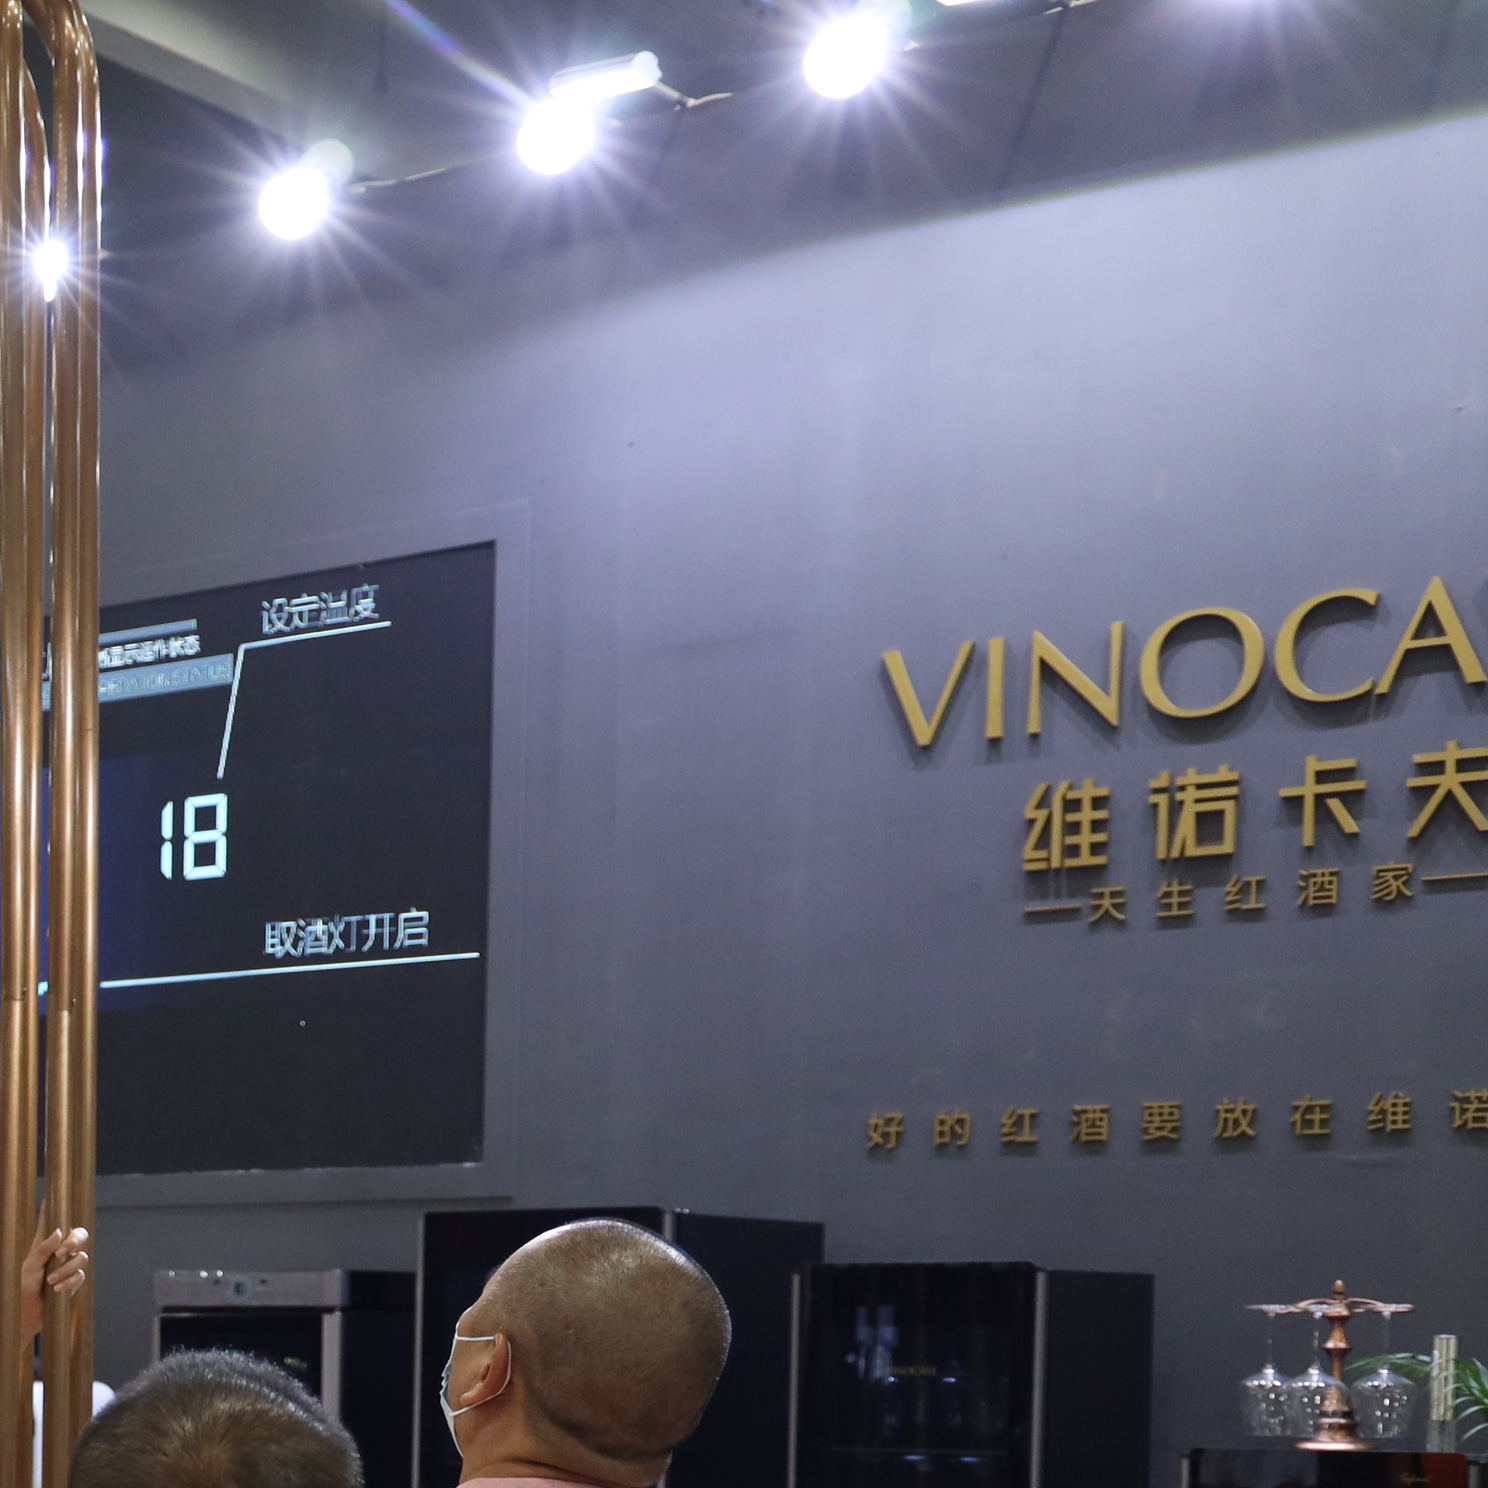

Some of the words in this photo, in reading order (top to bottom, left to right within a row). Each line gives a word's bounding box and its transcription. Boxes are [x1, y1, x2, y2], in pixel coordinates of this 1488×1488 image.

[261, 582, 380, 635] 设定温度
[881, 574, 1488, 748] VINOCA
[160, 792, 228, 881] 18
[1023, 740, 1488, 872] 维诺卡夫
[1086, 861, 1416, 924] 天生红酒家
[264, 905, 431, 960] 取酒灯开启
[866, 1088, 1488, 1151] 好的红酒要放在维诺
